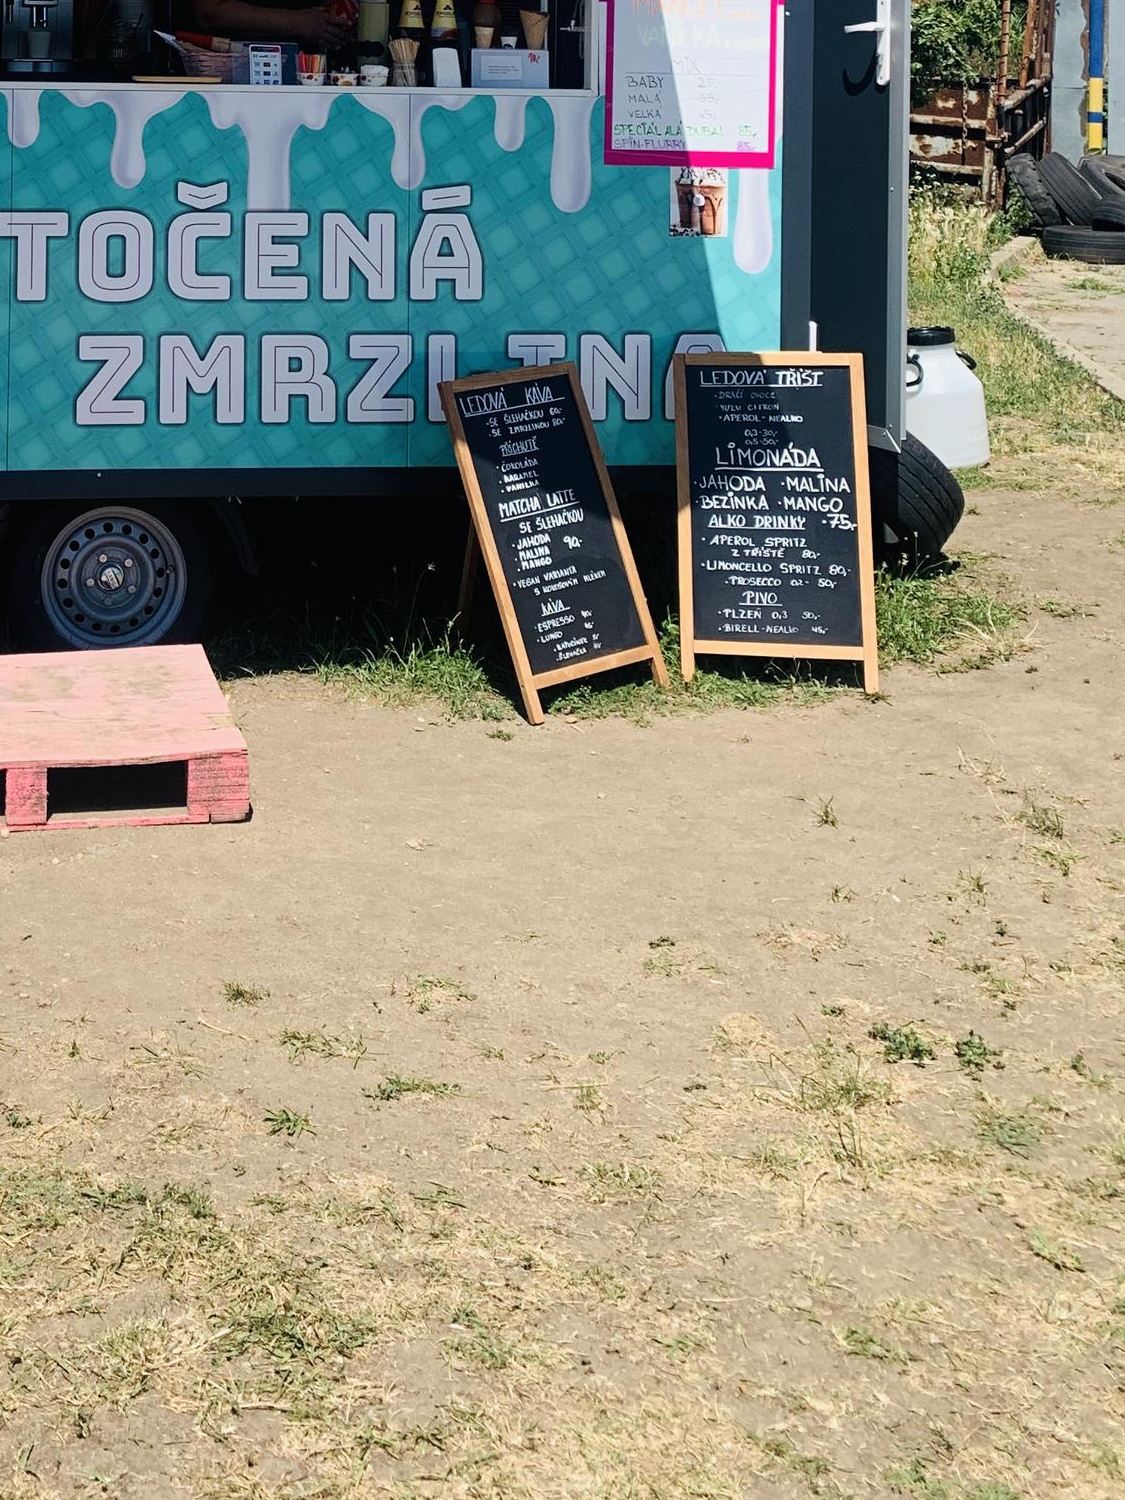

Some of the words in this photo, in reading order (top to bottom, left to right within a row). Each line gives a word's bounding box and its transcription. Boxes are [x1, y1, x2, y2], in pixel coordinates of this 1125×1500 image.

[626, 76, 665, 89] BABY
[627, 90, 662, 104] MALÁ
[627, 105, 662, 119] VELKÁ
[459, 387, 508, 416] LEDOVÁ
[524, 382, 555, 405] KÁVA
[715, 442, 821, 467] LIMONÁDA
[699, 474, 767, 491] JAHODA
[785, 474, 851, 493] MALINA
[498, 496, 542, 519] MATCHA
[545, 488, 577, 508] LATTE
[698, 492, 770, 510] BEZINKA
[782, 497, 844, 512] MANGO
[518, 521, 533, 534] SE
[535, 508, 585, 531] ŠLEHAČKOU
[708, 514, 747, 527] ALKO
[753, 515, 806, 529] DRINKY
[516, 533, 552, 551] JAHODA
[709, 534, 755, 547] APEROL
[764, 537, 808, 548] SPRITZ
[518, 545, 551, 562] MALINA
[731, 549, 741, 557] Z
[521, 556, 553, 571] MANGO
[706, 560, 773, 573] LIMONCELLO
[779, 563, 822, 575] SPRITZ
[729, 576, 782, 586] PROSECCO
[742, 590, 778, 605] PIVO
[541, 598, 565, 616] KÁVA
[537, 615, 576, 633] ESPRESSO
